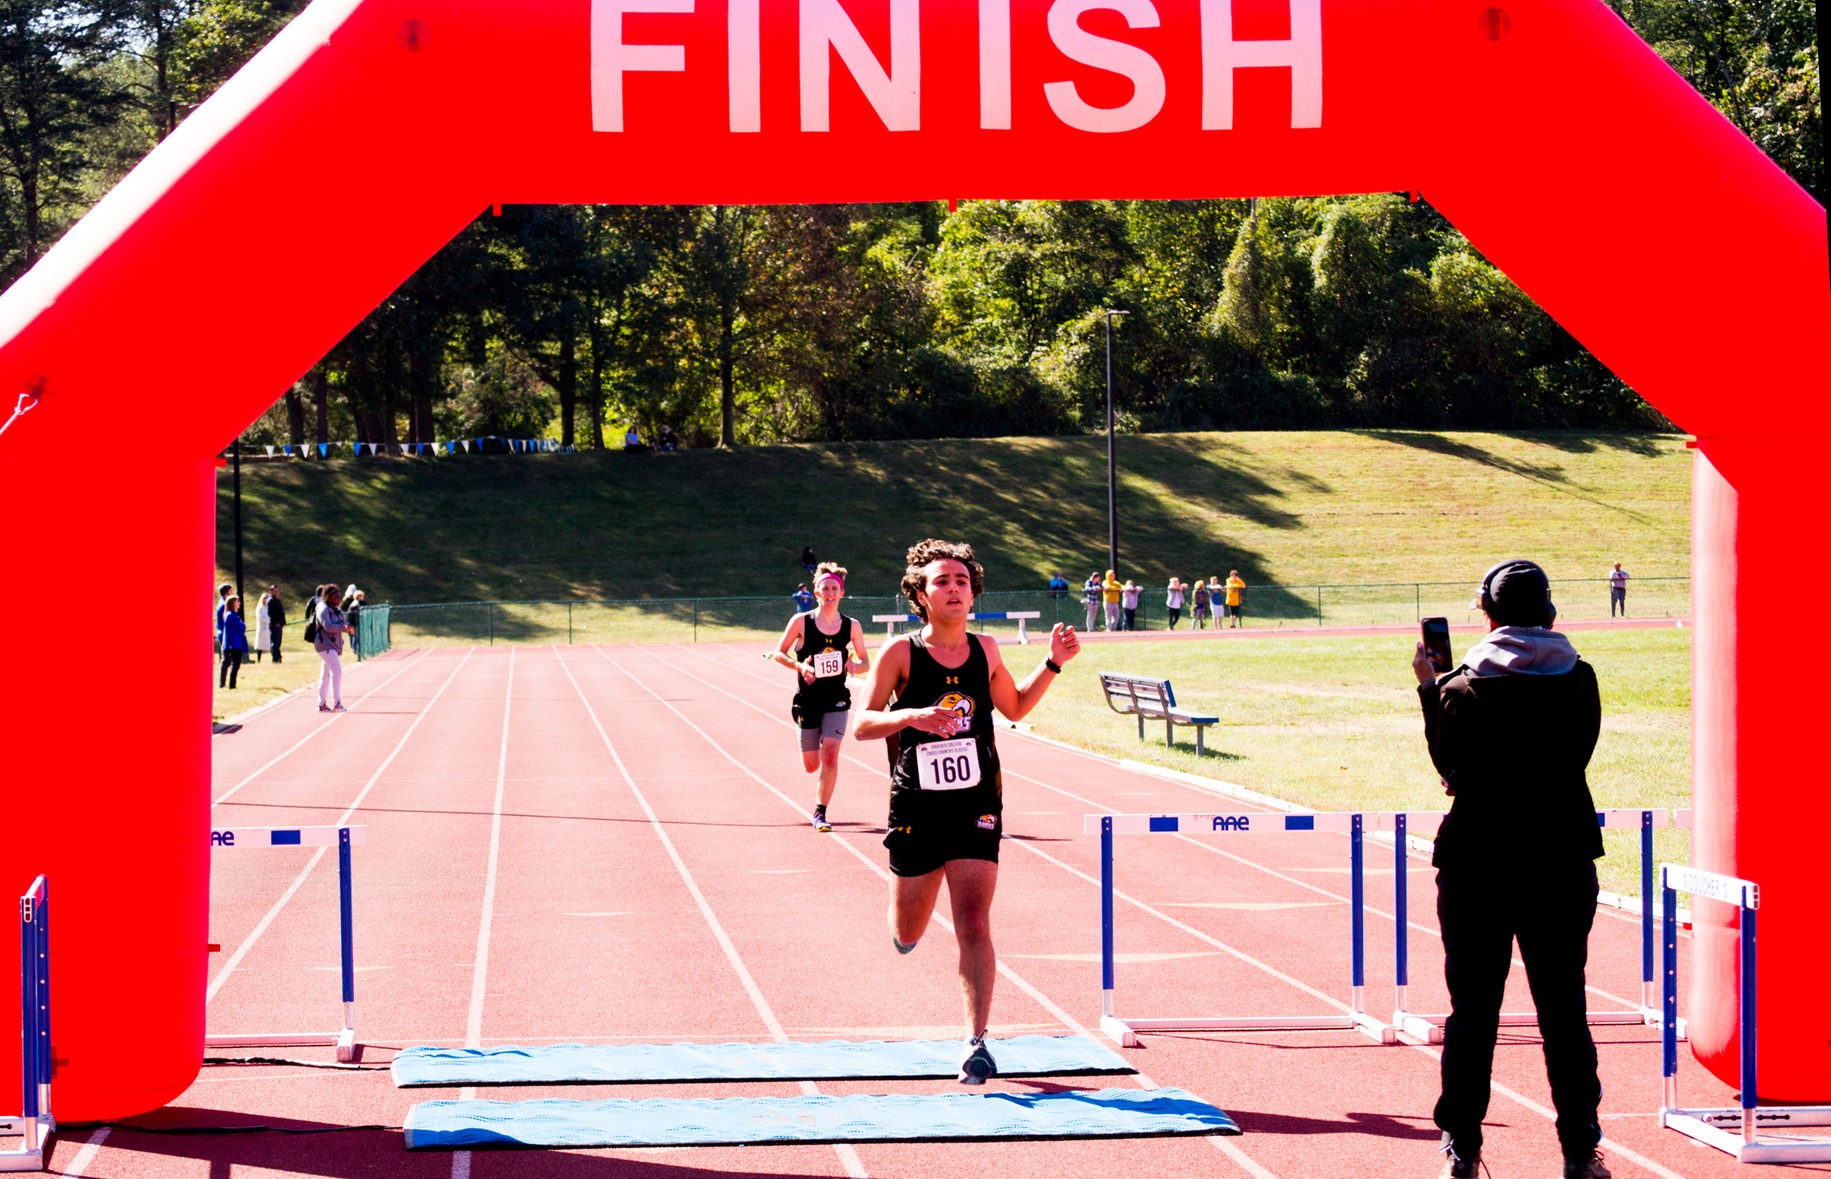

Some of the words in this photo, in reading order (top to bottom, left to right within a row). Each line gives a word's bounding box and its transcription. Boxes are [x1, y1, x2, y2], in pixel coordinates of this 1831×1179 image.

[590, 0, 1323, 133] FINISH
[821, 660, 838, 674] 159
[931, 755, 971, 784] 160
